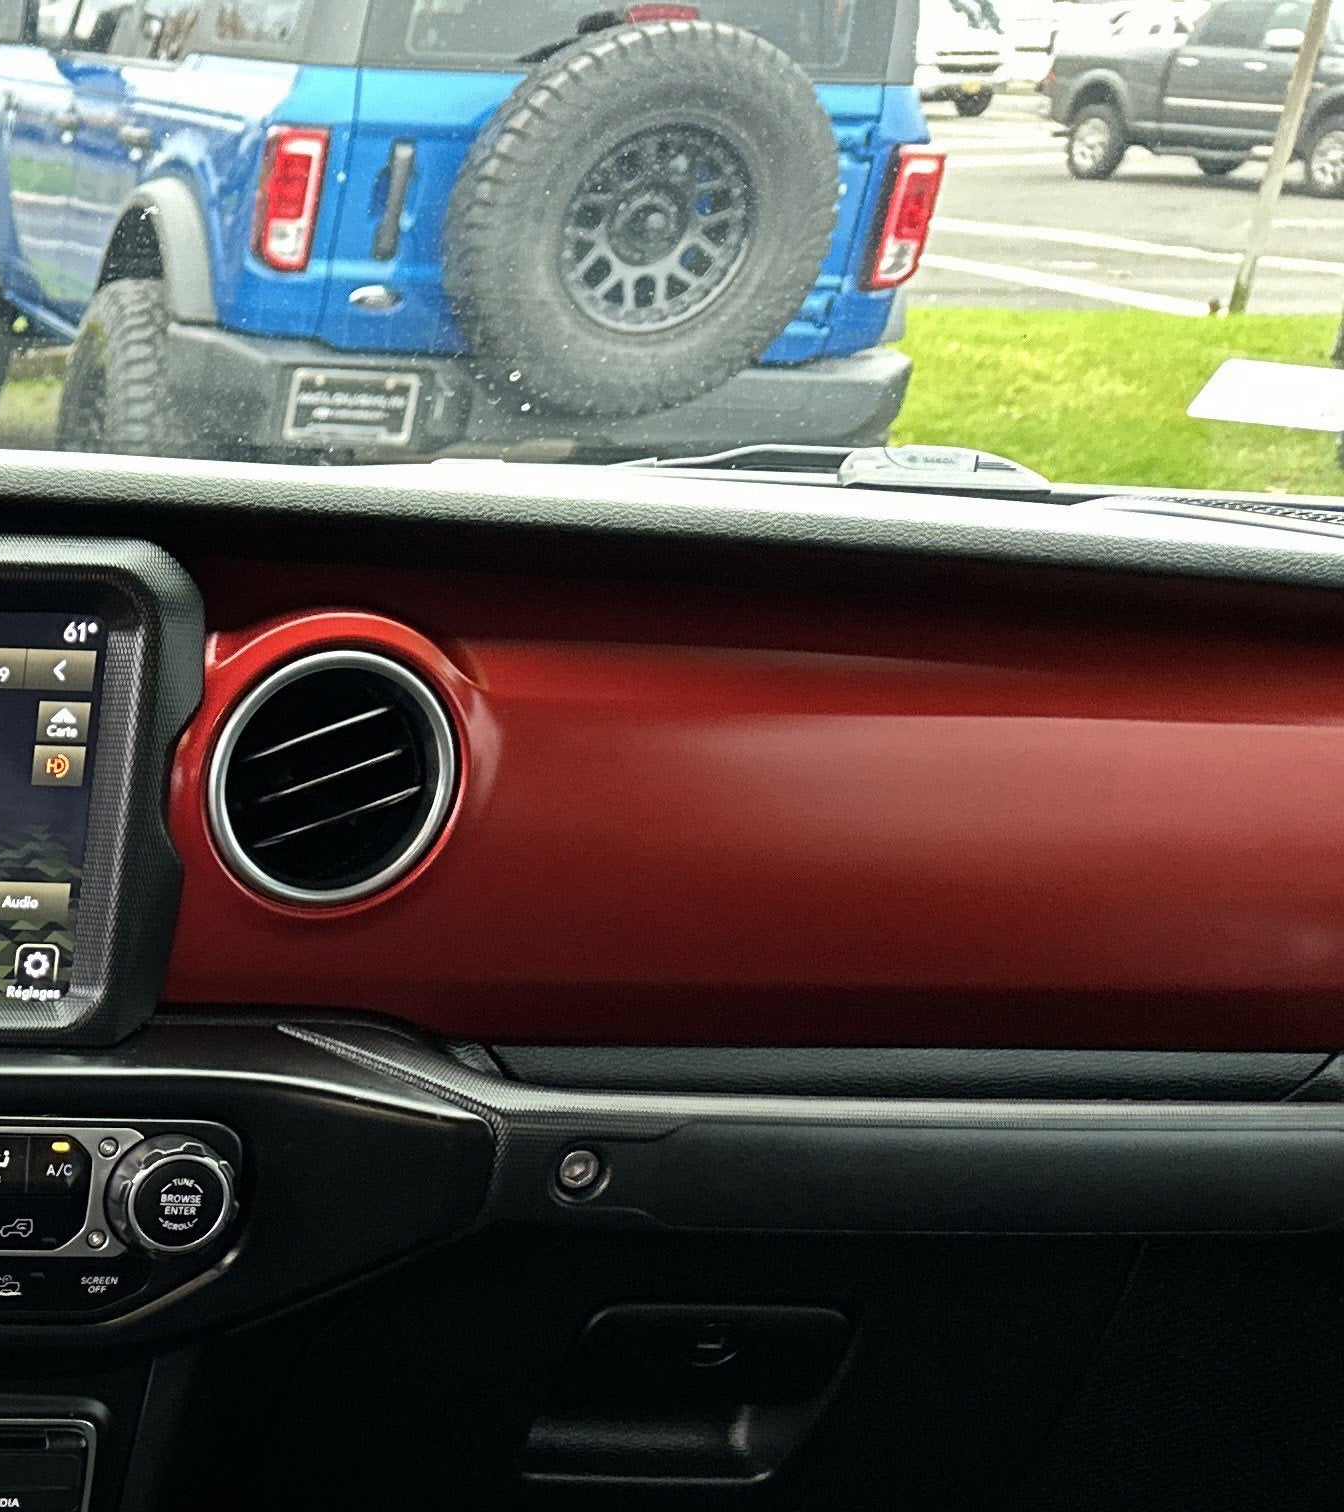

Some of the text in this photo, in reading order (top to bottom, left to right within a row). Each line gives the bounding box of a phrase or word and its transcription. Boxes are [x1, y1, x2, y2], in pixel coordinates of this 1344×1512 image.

[63, 621, 98, 643] 61°
[2, 895, 39, 909] Audio
[6, 986, 61, 1001] Réglages
[46, 1162, 73, 1177] A/C
[172, 1177, 195, 1188] TUNE
[160, 1193, 202, 1205] BROWSE
[164, 1206, 197, 1217] ENTER
[162, 1220, 194, 1231] SCROLL
[80, 1275, 119, 1286] SCREEN
[88, 1285, 107, 1294] OFF
